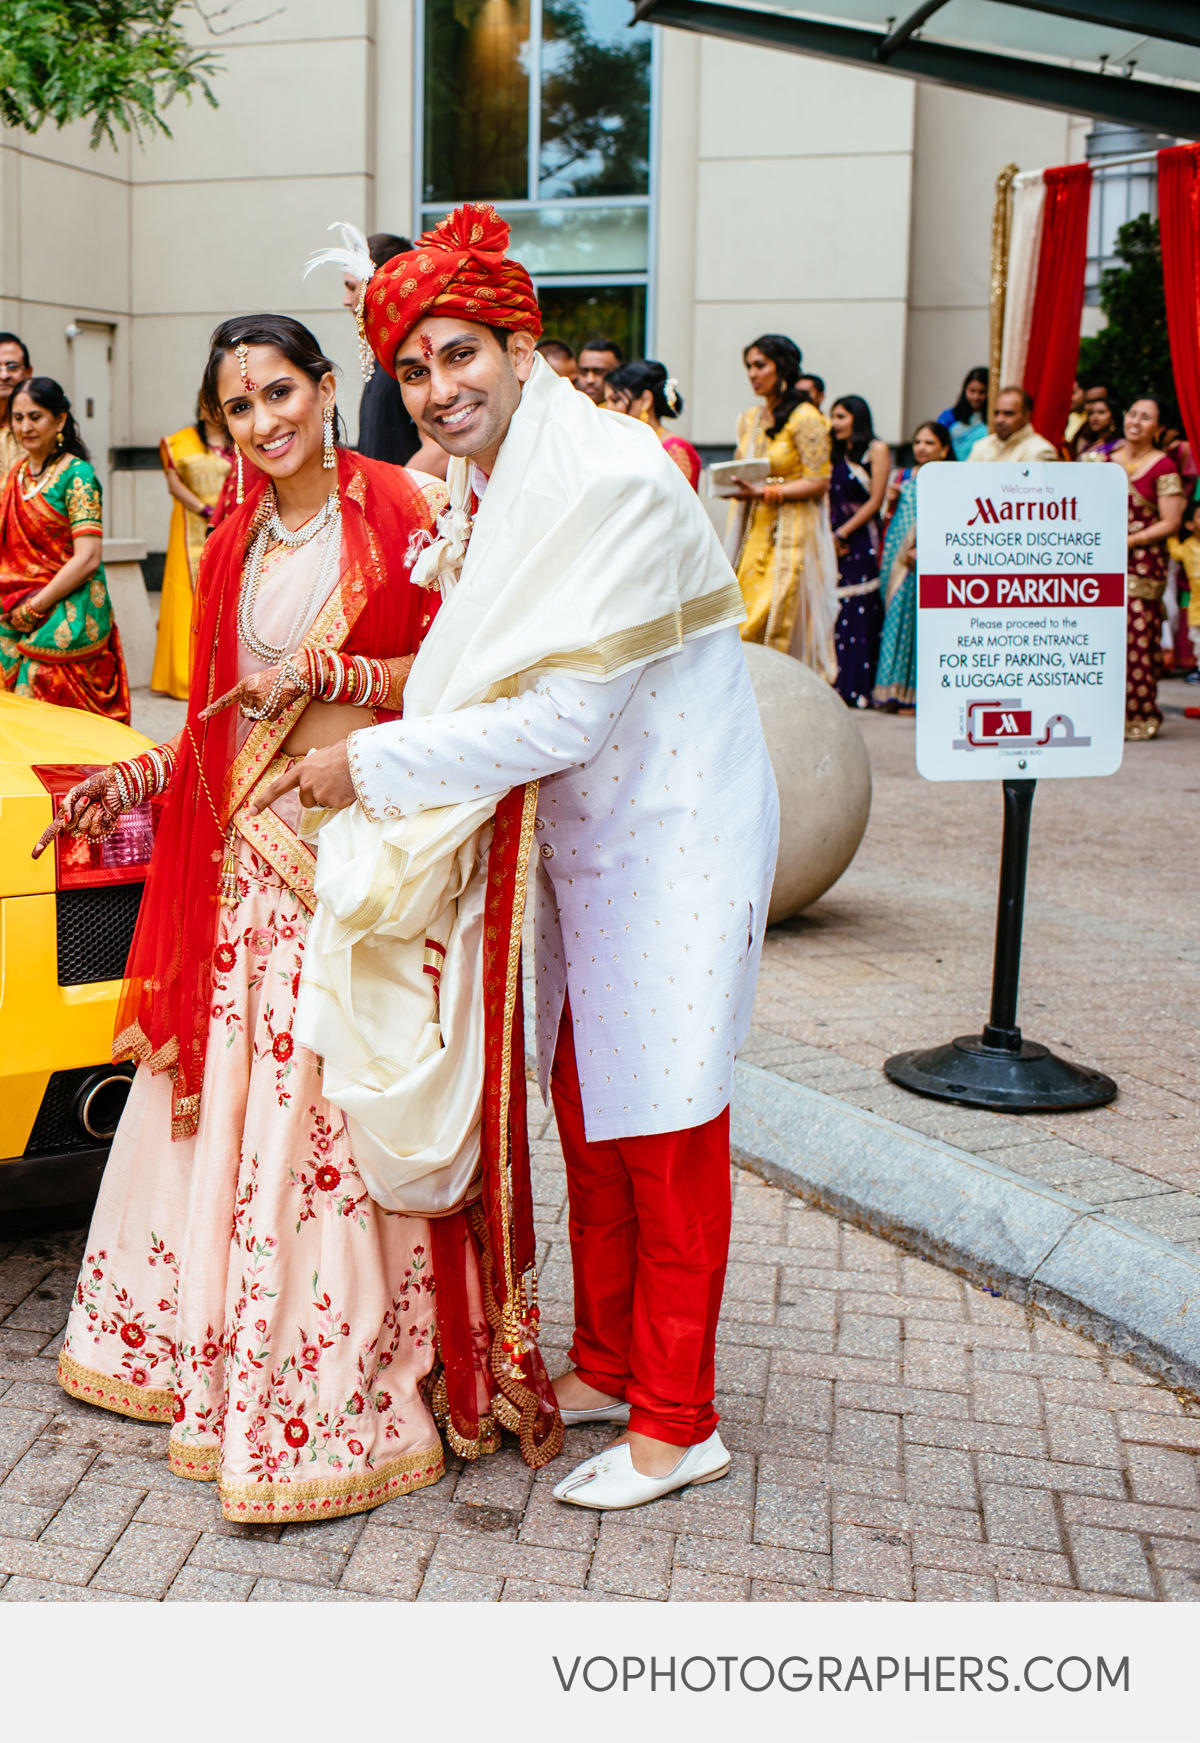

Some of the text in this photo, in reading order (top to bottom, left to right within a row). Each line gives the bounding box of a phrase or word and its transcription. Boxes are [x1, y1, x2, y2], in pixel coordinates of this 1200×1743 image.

[1001, 485, 1054, 494] Welcome to
[967, 497, 1078, 526] Marriott
[945, 532, 1101, 546] PASSENGER DISCHARGE
[953, 552, 1094, 566] & UNLOADING ZONE
[947, 577, 1099, 605] NO PARKING
[970, 617, 1077, 631] Please proceed to the
[957, 634, 1089, 647] REAR MOTOR ENTRANCE
[939, 652, 1106, 668] FOR SELF PARKING, VALET
[941, 671, 1104, 688] & LUGGAGE ASSISTANCE
